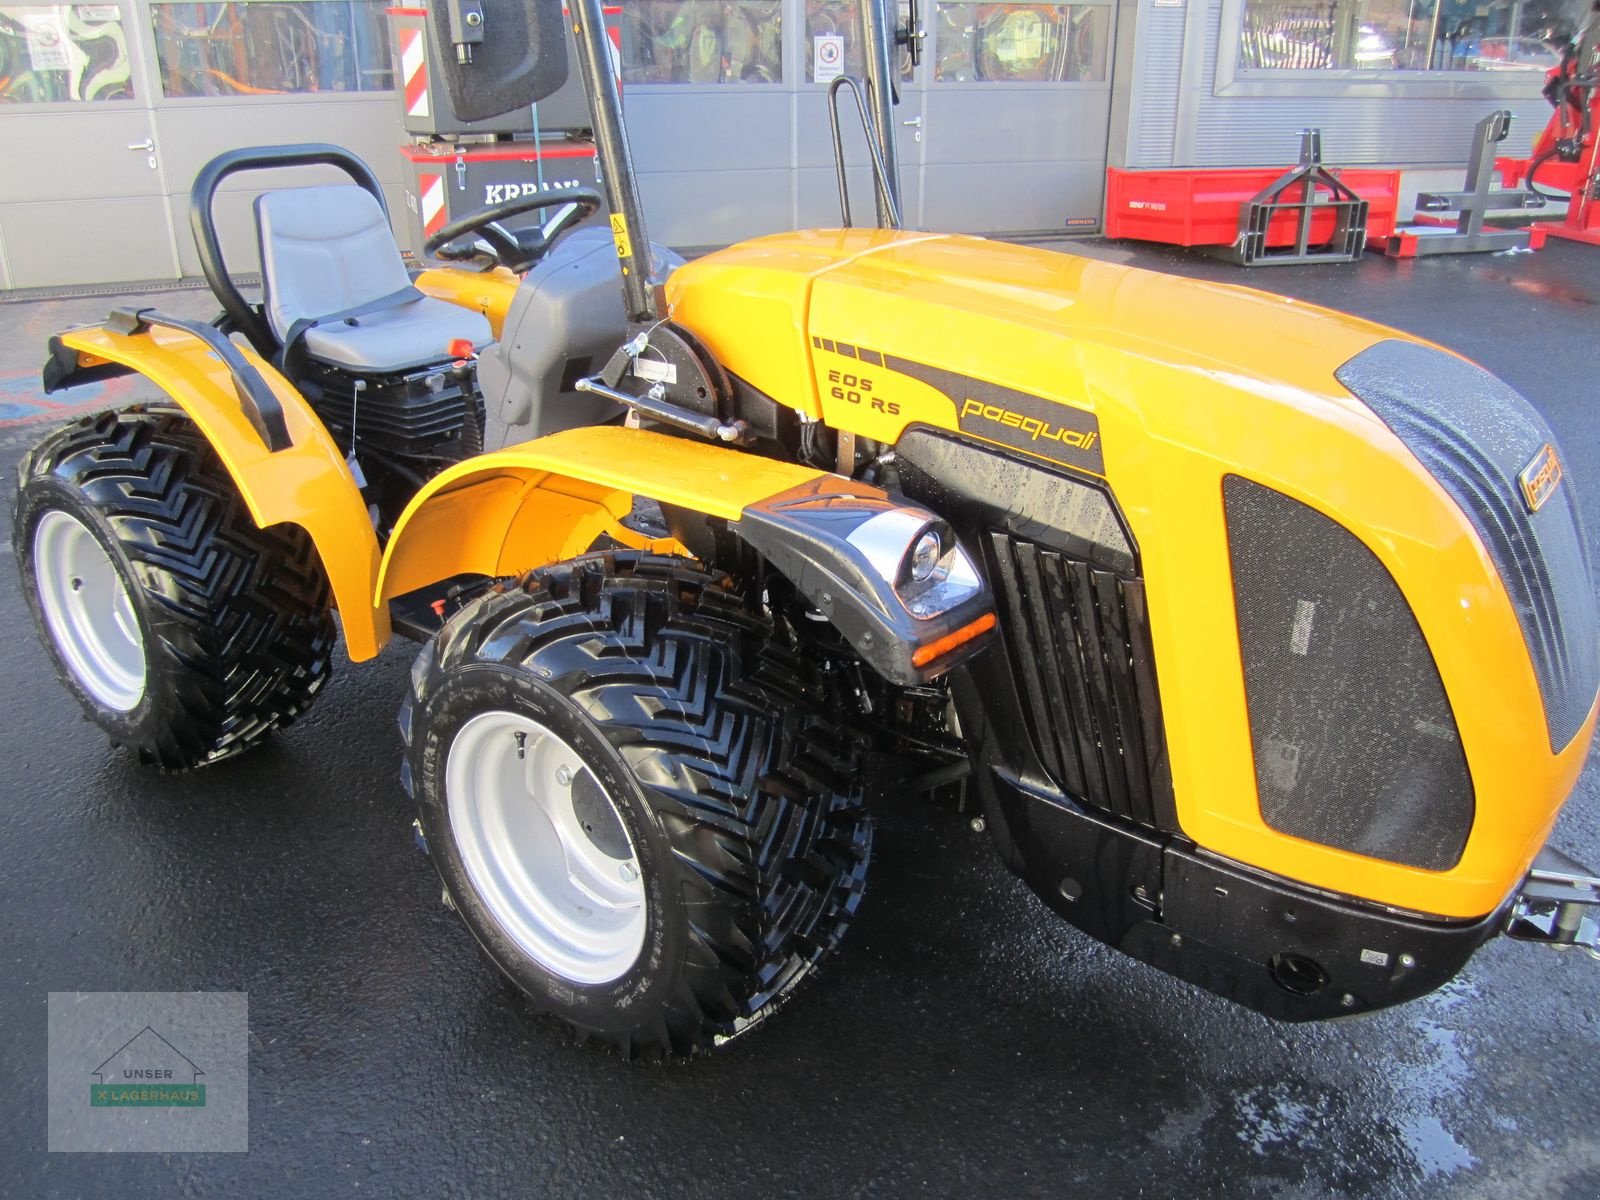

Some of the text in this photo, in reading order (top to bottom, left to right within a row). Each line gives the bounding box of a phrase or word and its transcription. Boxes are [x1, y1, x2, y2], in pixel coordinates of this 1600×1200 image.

[485, 182, 572, 204] KRP
[829, 370, 872, 392] EOS
[831, 387, 900, 415] 60 RS
[961, 399, 1097, 450] pasquali
